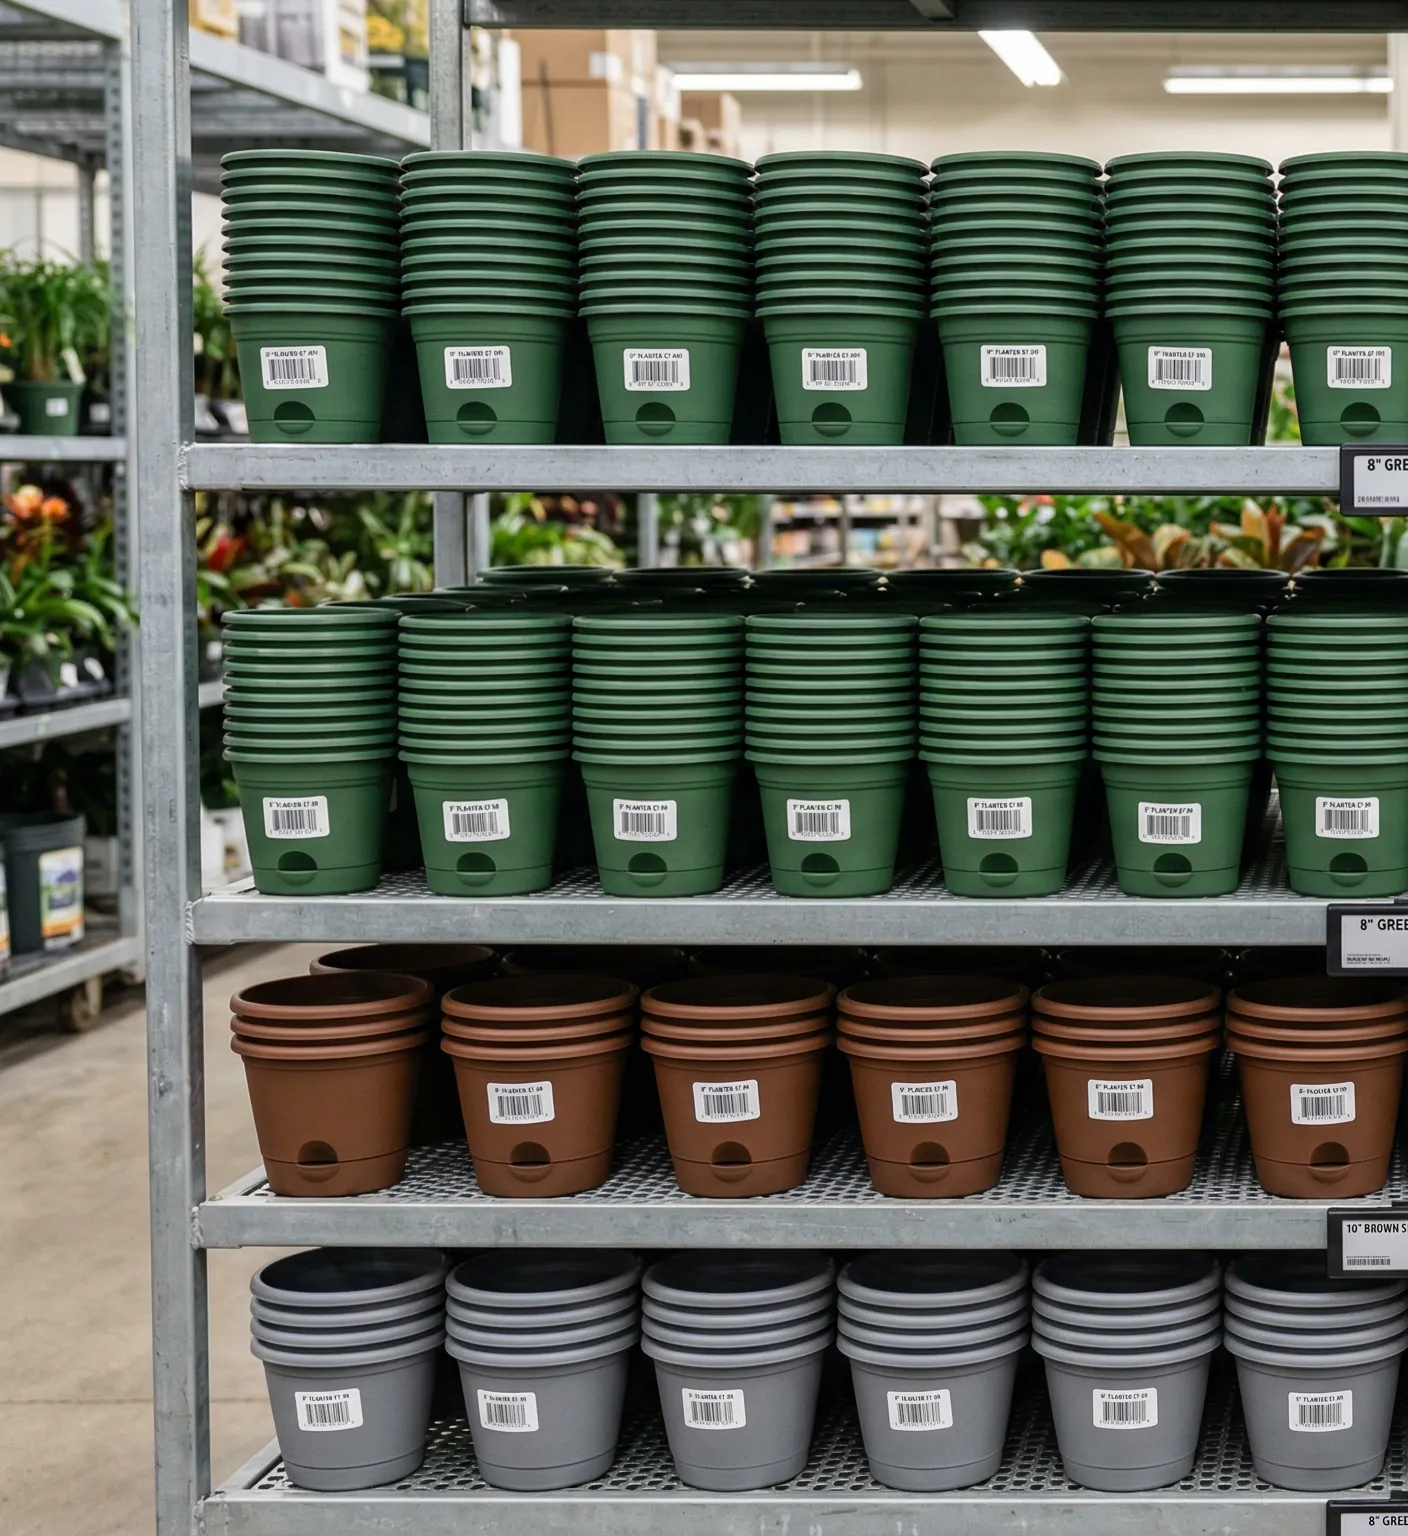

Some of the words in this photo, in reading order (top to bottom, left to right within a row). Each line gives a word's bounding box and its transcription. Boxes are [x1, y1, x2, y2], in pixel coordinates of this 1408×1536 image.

[1367, 458, 1381, 471] 8"
[1360, 919, 1374, 931] 8"
[1347, 1223, 1362, 1233] 10"
[1364, 1223, 1399, 1234] BROWN
[1368, 1516, 1380, 1526] 8"
